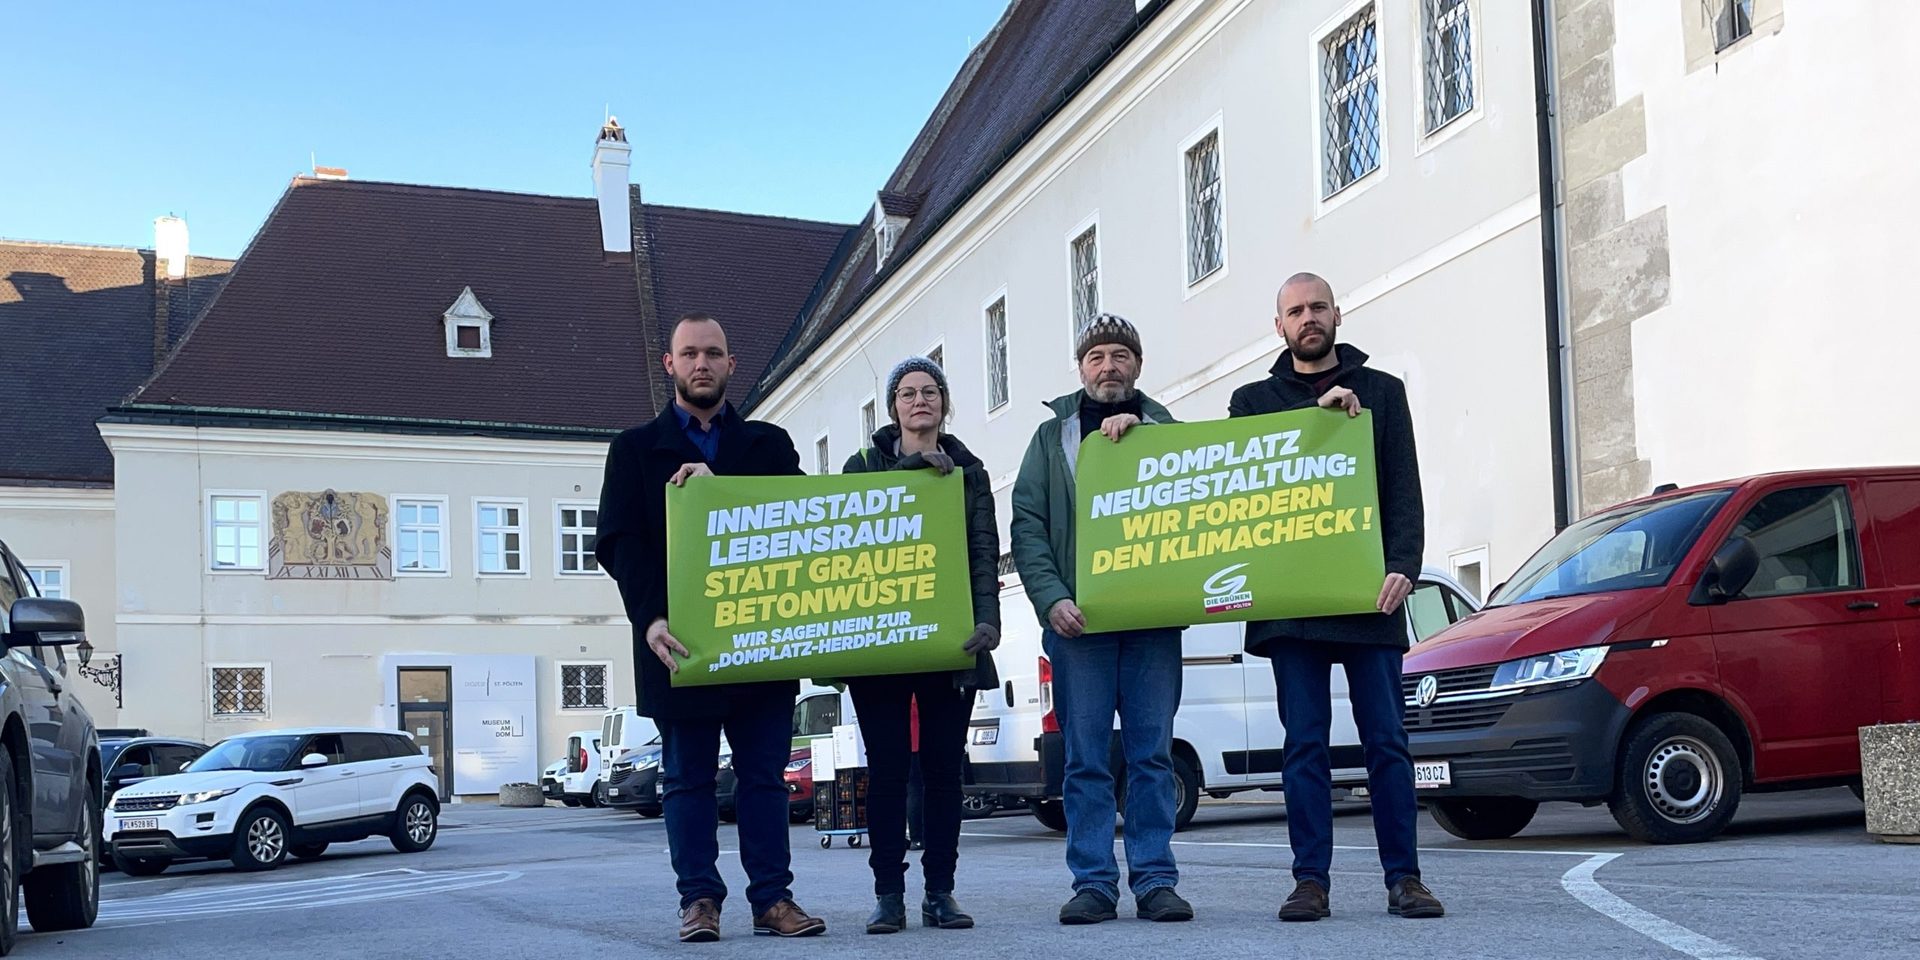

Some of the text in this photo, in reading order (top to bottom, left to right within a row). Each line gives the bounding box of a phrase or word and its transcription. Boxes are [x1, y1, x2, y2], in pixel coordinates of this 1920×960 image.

[1137, 429, 1301, 482] DOMPLATZ
[707, 486, 916, 536] INNENSTADT-
[1091, 453, 1356, 519] NEUGESTALTUNG:
[1122, 482, 1334, 541] WIR FORDERN
[710, 514, 922, 567] LEBENSRAUM
[1092, 507, 1372, 575] DEN KLIMACHECK !
[704, 543, 936, 598] STATT GRAUER
[714, 573, 936, 628] BETONWÜSTE
[1206, 593, 1250, 606] DIE GRÜNEN
[732, 611, 911, 649] WIR SAGEN NEIN ZUR
[1416, 766, 1446, 781] 613 CZ
